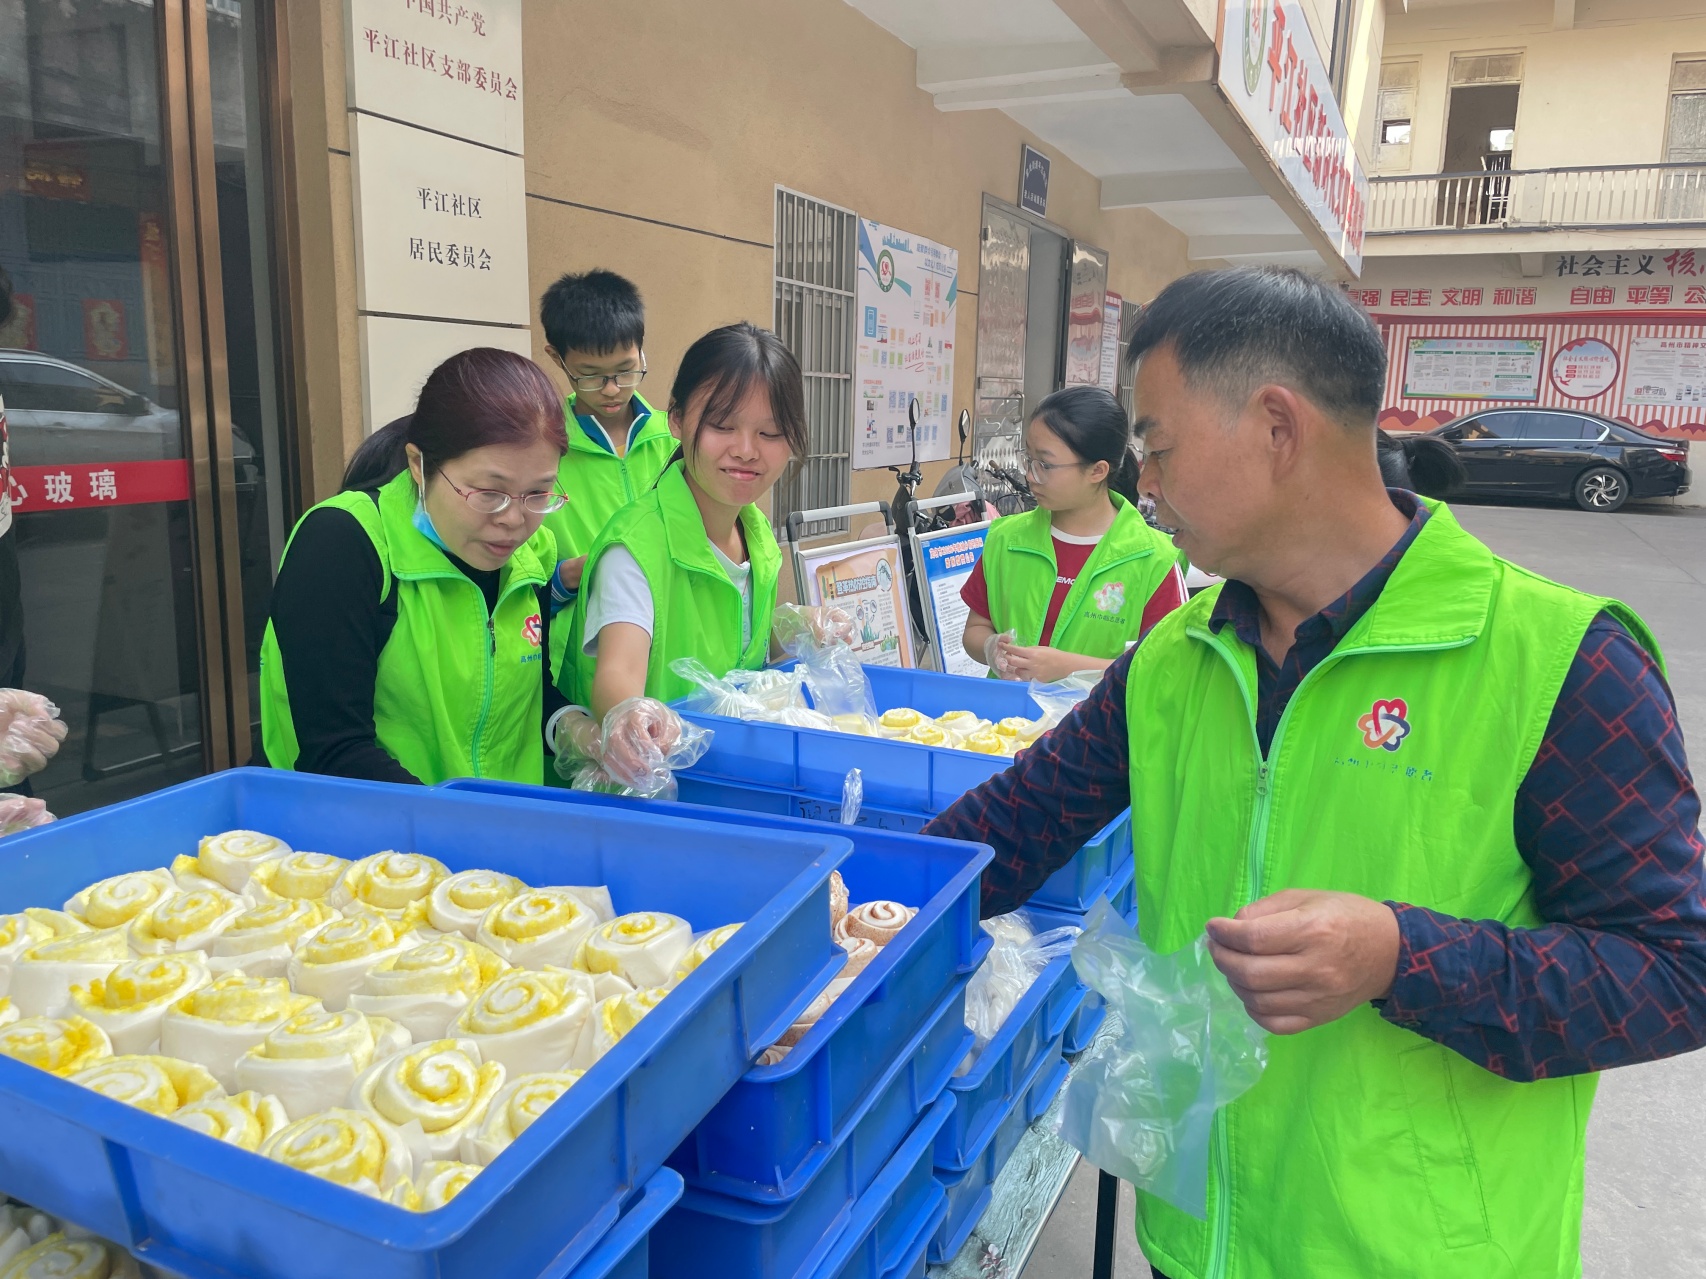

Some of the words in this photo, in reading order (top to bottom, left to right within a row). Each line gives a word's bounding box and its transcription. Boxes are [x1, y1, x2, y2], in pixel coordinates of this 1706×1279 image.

[406, 0, 486, 37] 国共产党
[362, 26, 518, 101] 平江社区支部委员会
[416, 186, 482, 219] 平江社区
[409, 237, 492, 271] 居民委员会
[1390, 288, 1431, 307] 民主
[1440, 287, 1483, 306] 文明
[1492, 287, 1536, 306] 和谐
[1569, 285, 1615, 305] 自由
[1626, 285, 1672, 305] 平等
